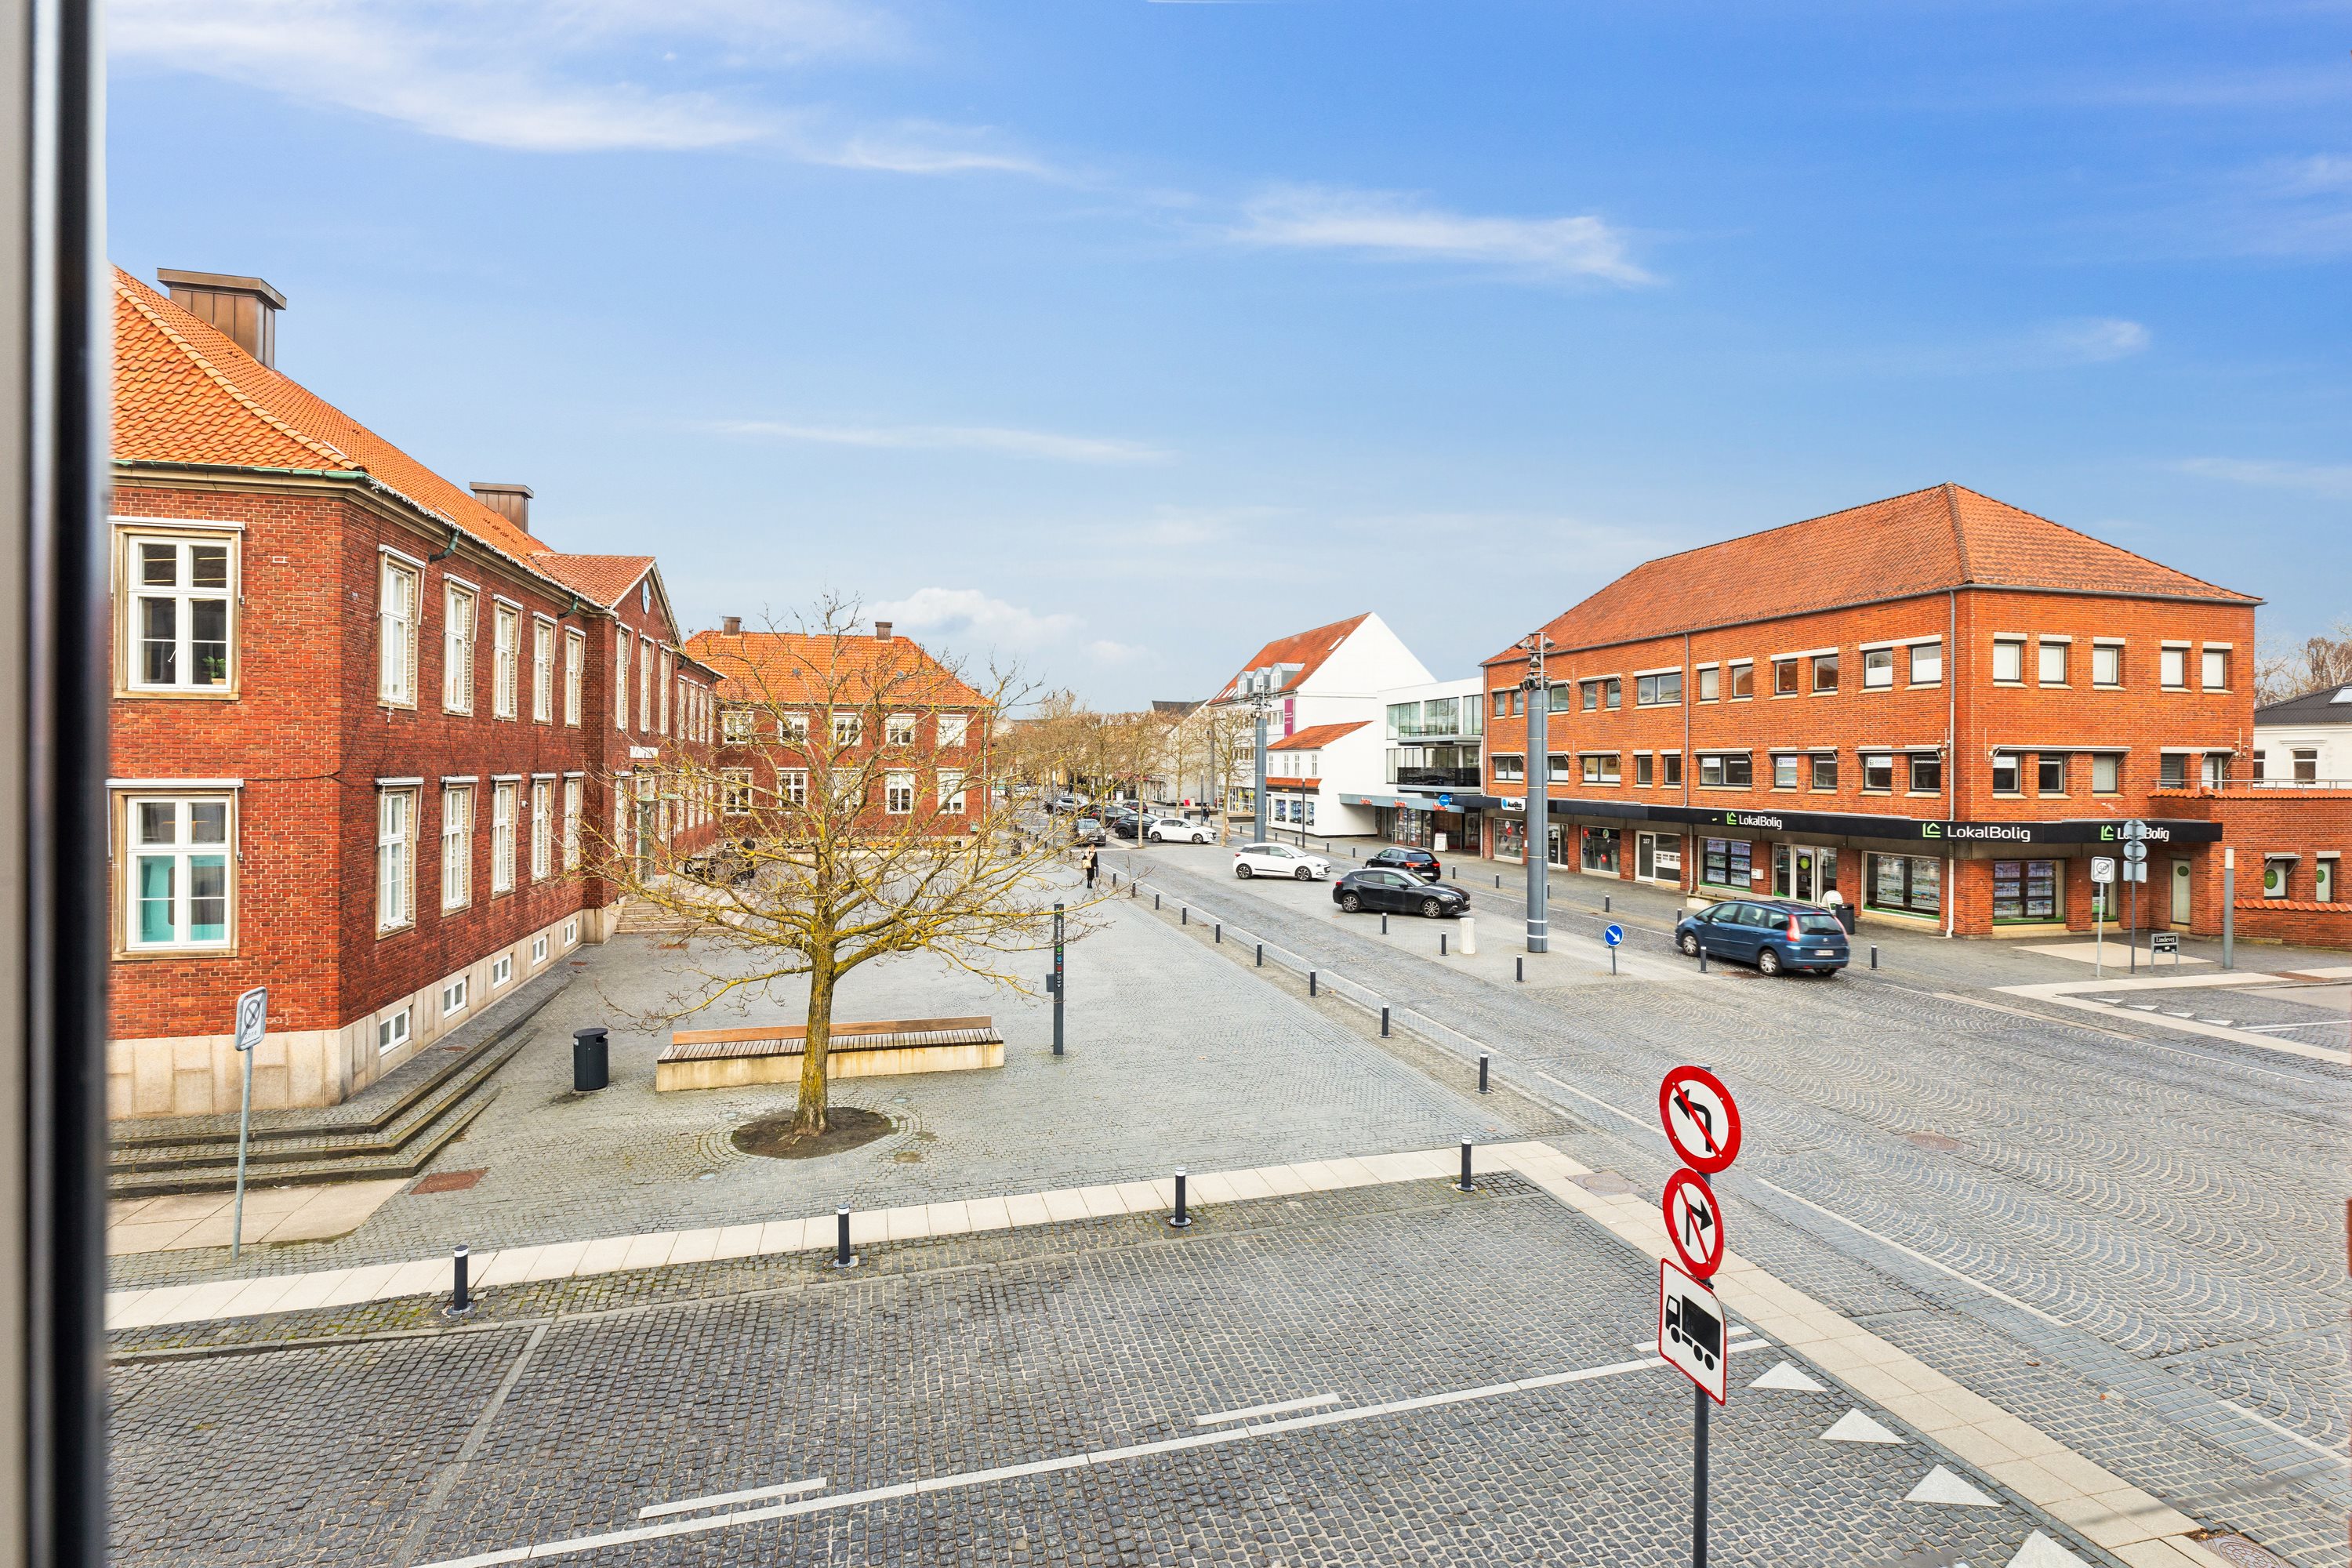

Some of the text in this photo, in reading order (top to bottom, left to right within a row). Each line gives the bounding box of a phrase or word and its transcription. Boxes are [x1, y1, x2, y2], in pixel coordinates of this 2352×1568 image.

[1739, 815, 1782, 830] LokalBolig
[1947, 826, 2031, 842] LokalBolig
[2117, 827, 2169, 842] LBolig
